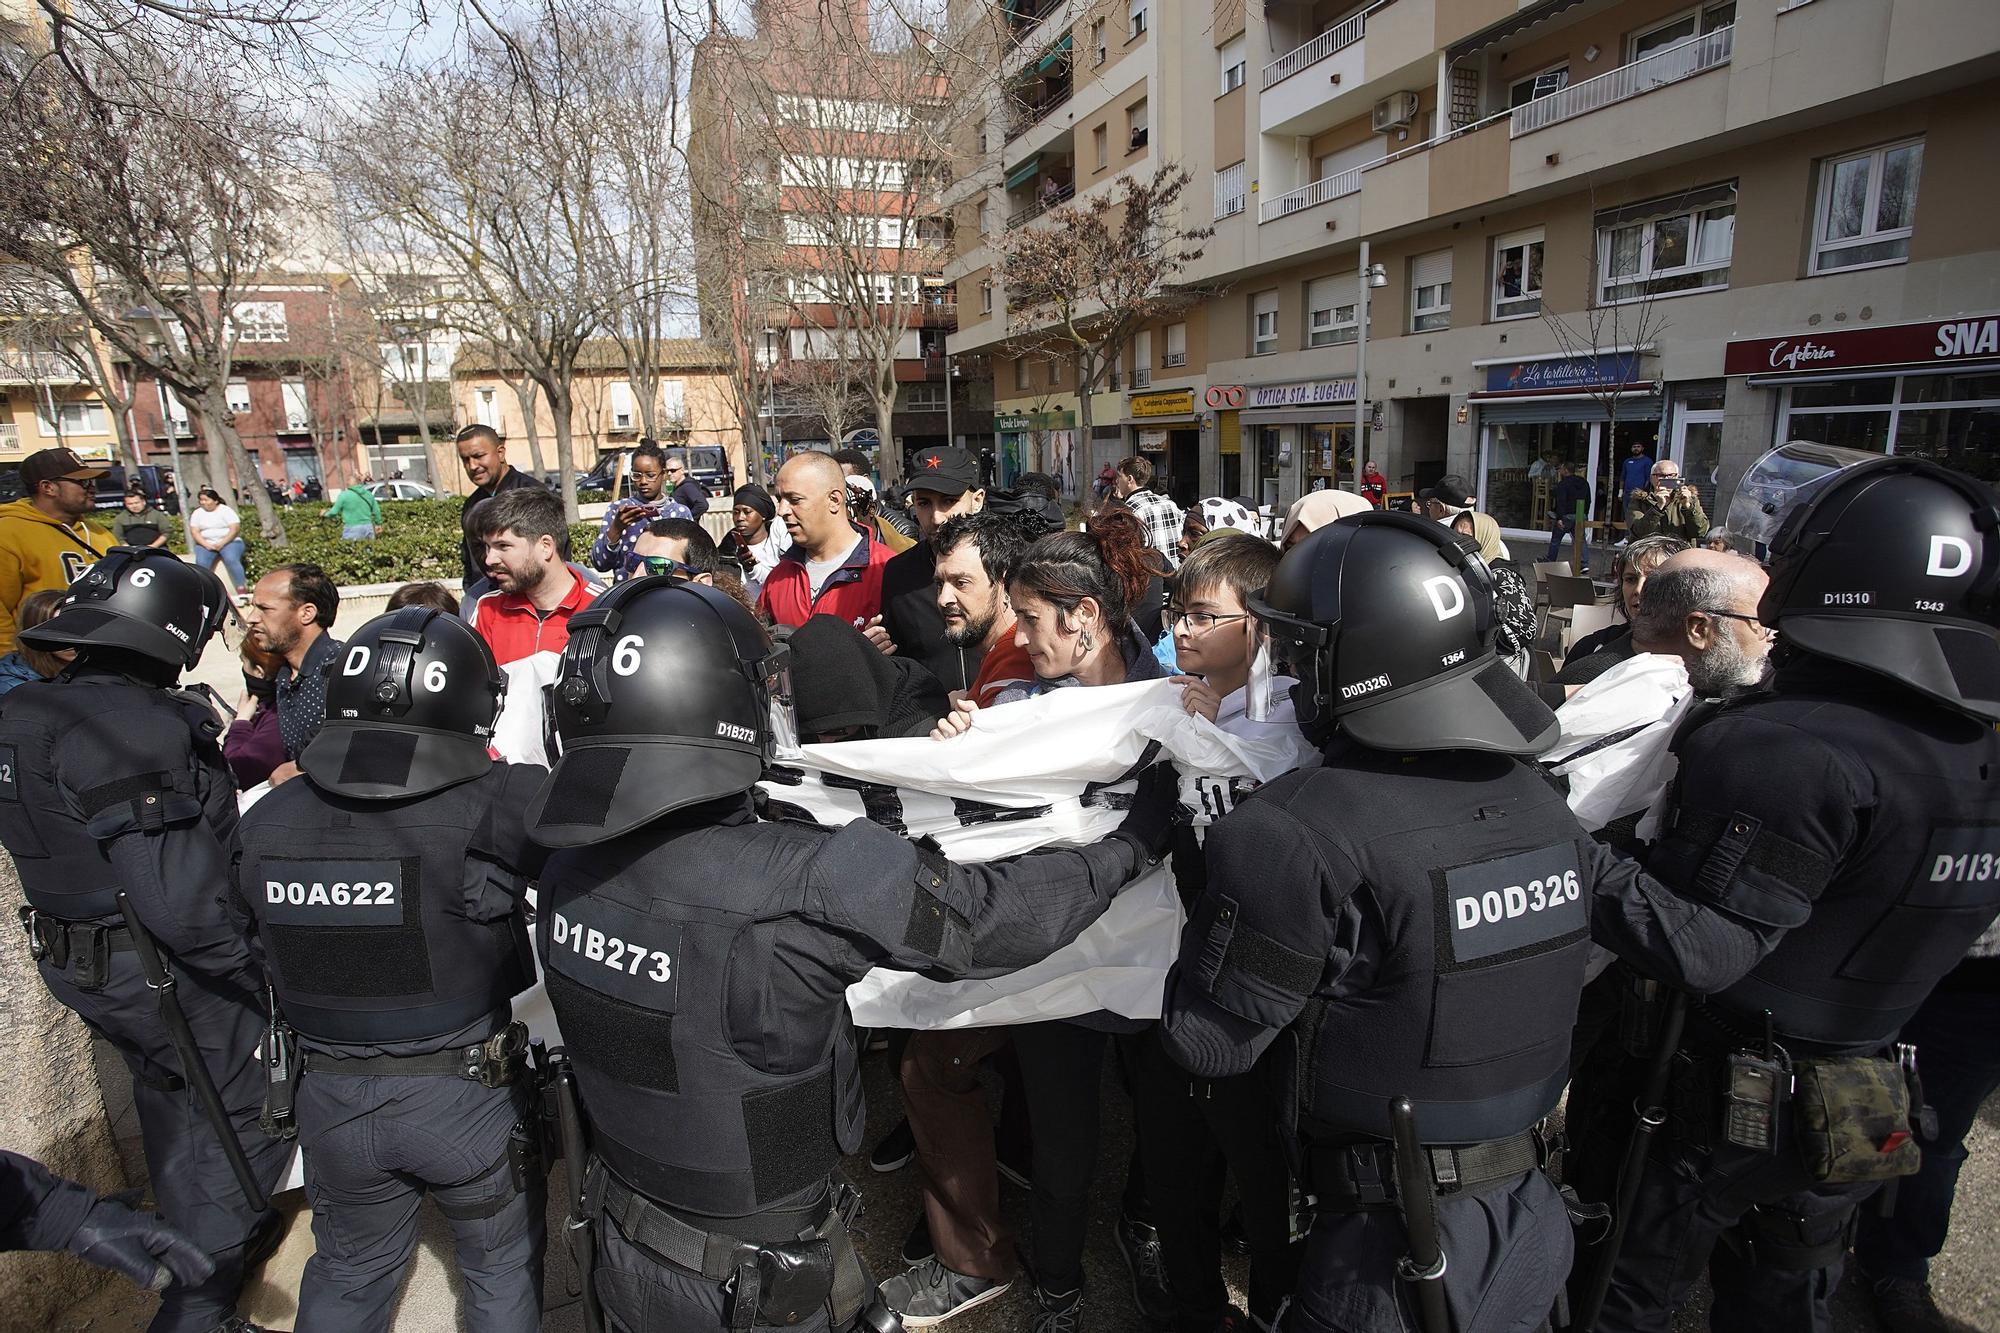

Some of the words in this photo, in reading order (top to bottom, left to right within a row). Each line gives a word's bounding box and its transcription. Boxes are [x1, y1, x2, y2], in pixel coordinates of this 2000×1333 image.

[1523, 363, 1541, 385] La
[1926, 535, 1973, 578] D
[129, 567, 156, 588] 6
[1422, 575, 1465, 622] D
[1914, 600, 1945, 612] 1343
[611, 634, 645, 677] 6
[1441, 650, 1465, 666] 1364
[342, 645, 371, 677] D
[423, 660, 449, 693] 6
[1341, 675, 1388, 699] D0D326
[342, 709, 358, 718] 1579
[717, 721, 755, 742] D1B273
[266, 880, 395, 906] D0A622
[1455, 869, 1580, 930] D0D326
[552, 912, 672, 983] D1B273
